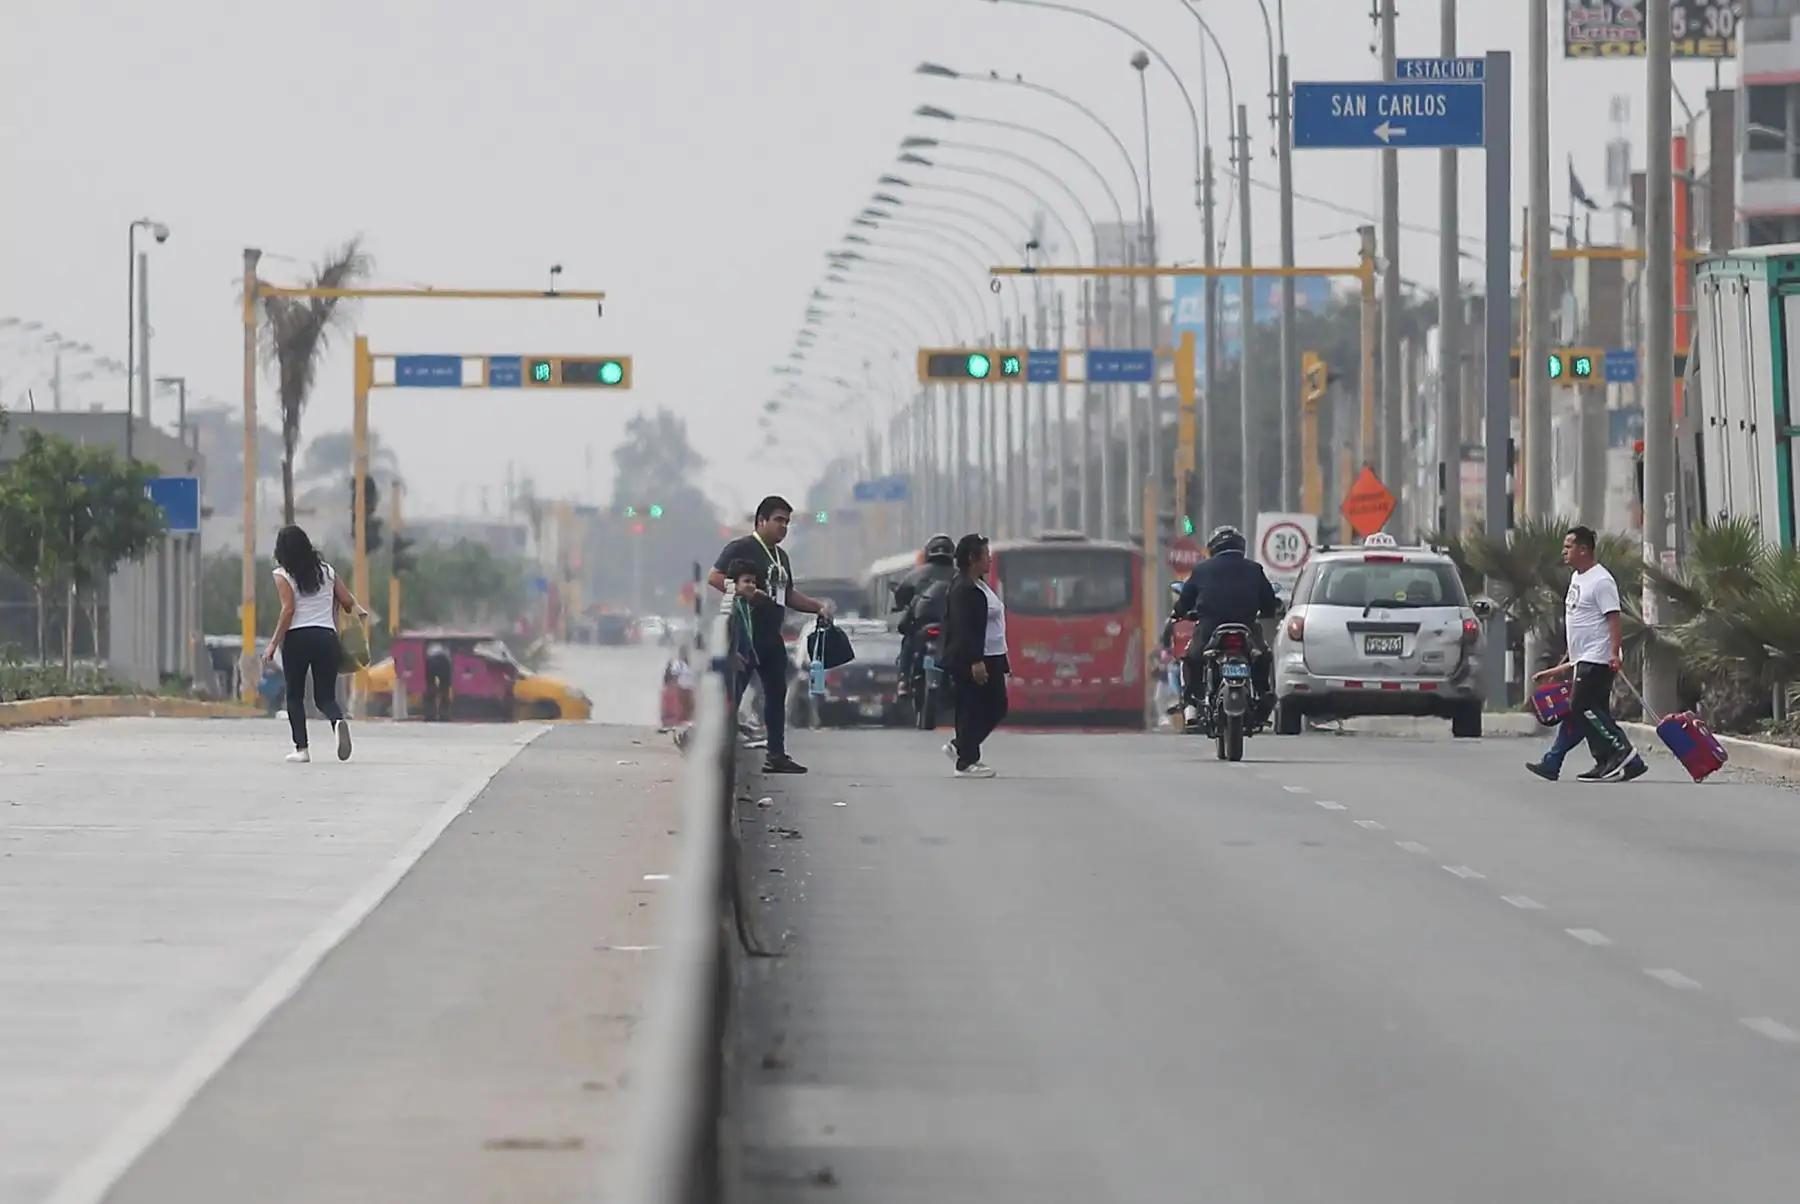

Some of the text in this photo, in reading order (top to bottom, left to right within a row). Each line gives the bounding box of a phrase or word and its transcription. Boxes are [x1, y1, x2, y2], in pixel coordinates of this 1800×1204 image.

[1407, 61, 1475, 77] ESTACION
[1331, 94, 1446, 116] SAN CARLOS
[1275, 533, 1299, 550] 30
[1368, 537, 1394, 546] TAXI
